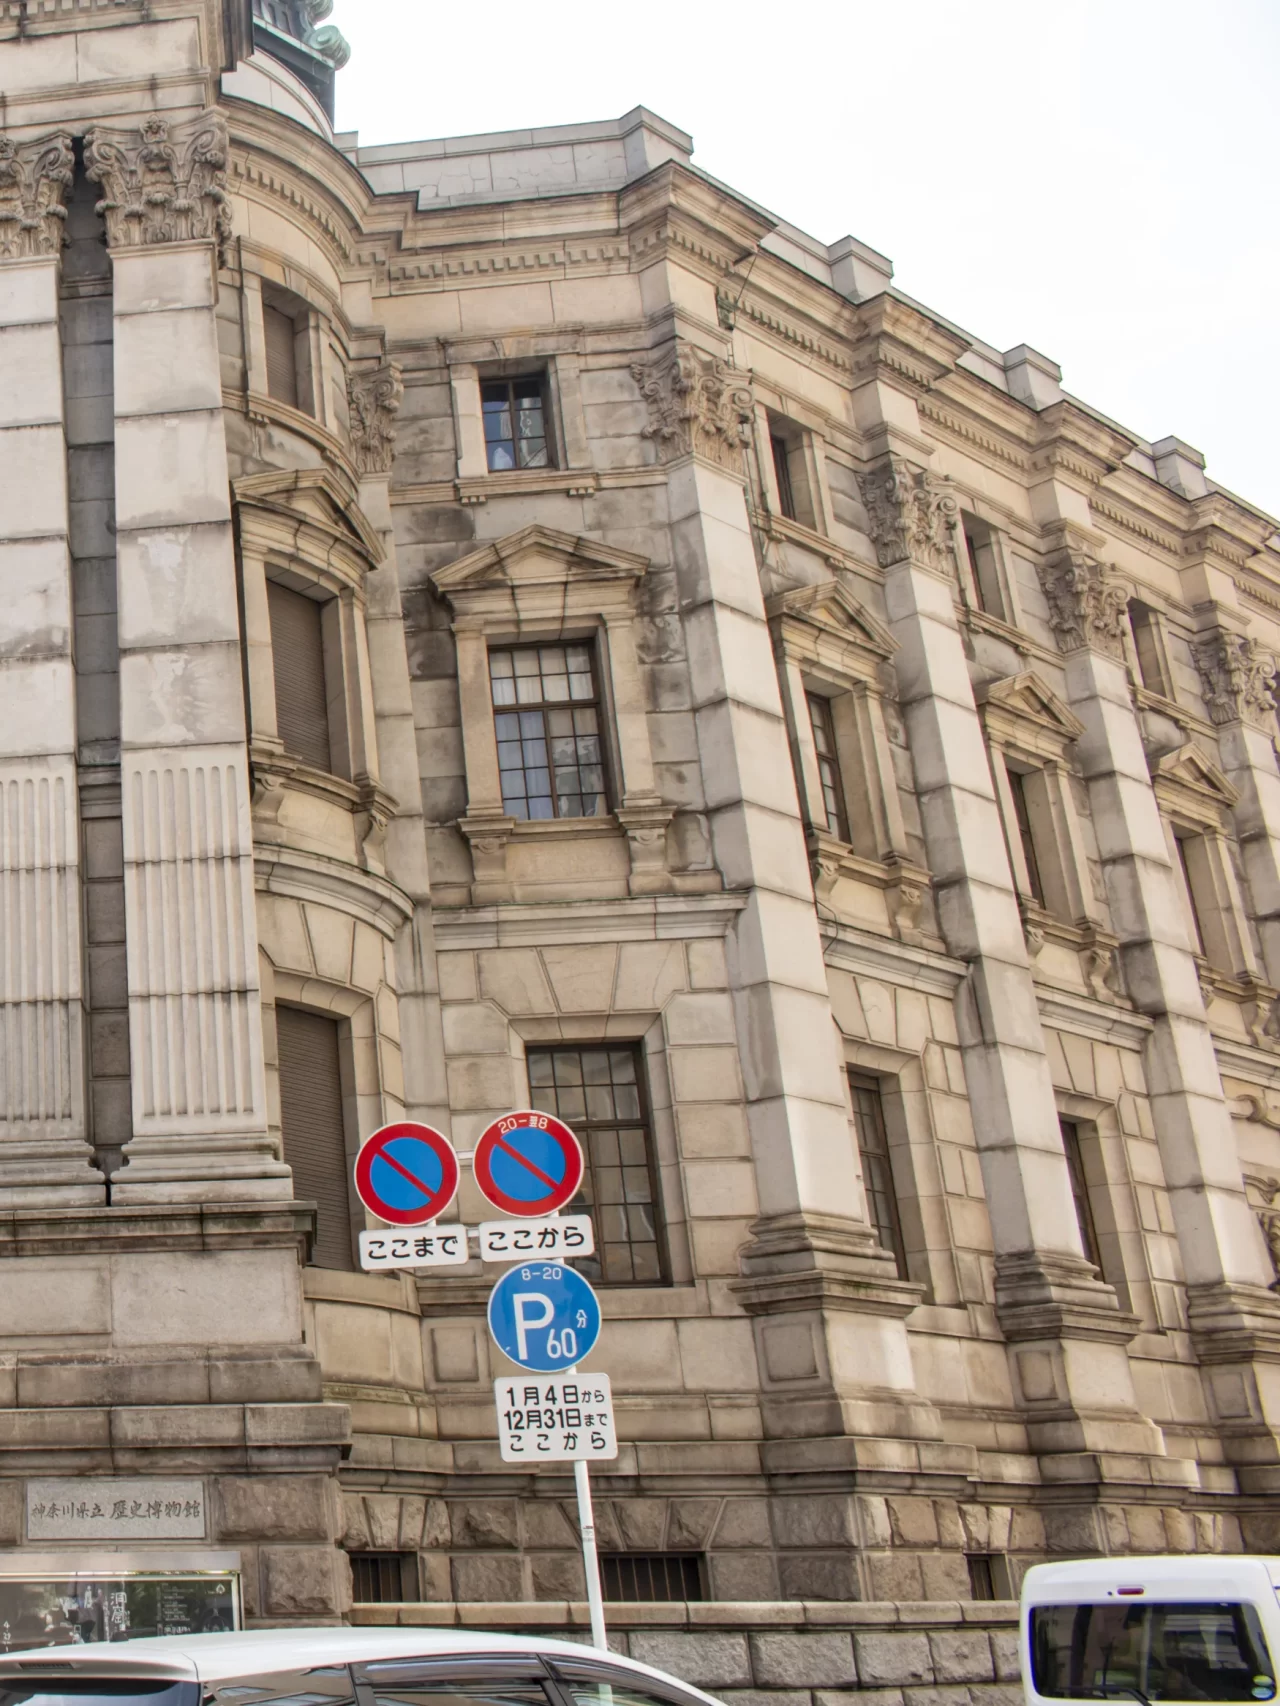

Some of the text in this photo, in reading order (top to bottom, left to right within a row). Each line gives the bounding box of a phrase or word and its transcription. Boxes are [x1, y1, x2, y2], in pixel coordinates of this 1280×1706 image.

[368, 1235, 459, 1260] ここまで
[488, 1226, 585, 1252] ここから
[521, 1267, 562, 1281] 8-20
[512, 1292, 555, 1360] P
[503, 1408, 609, 1431] 12月31日まで
[510, 1431, 607, 1452] ここから
